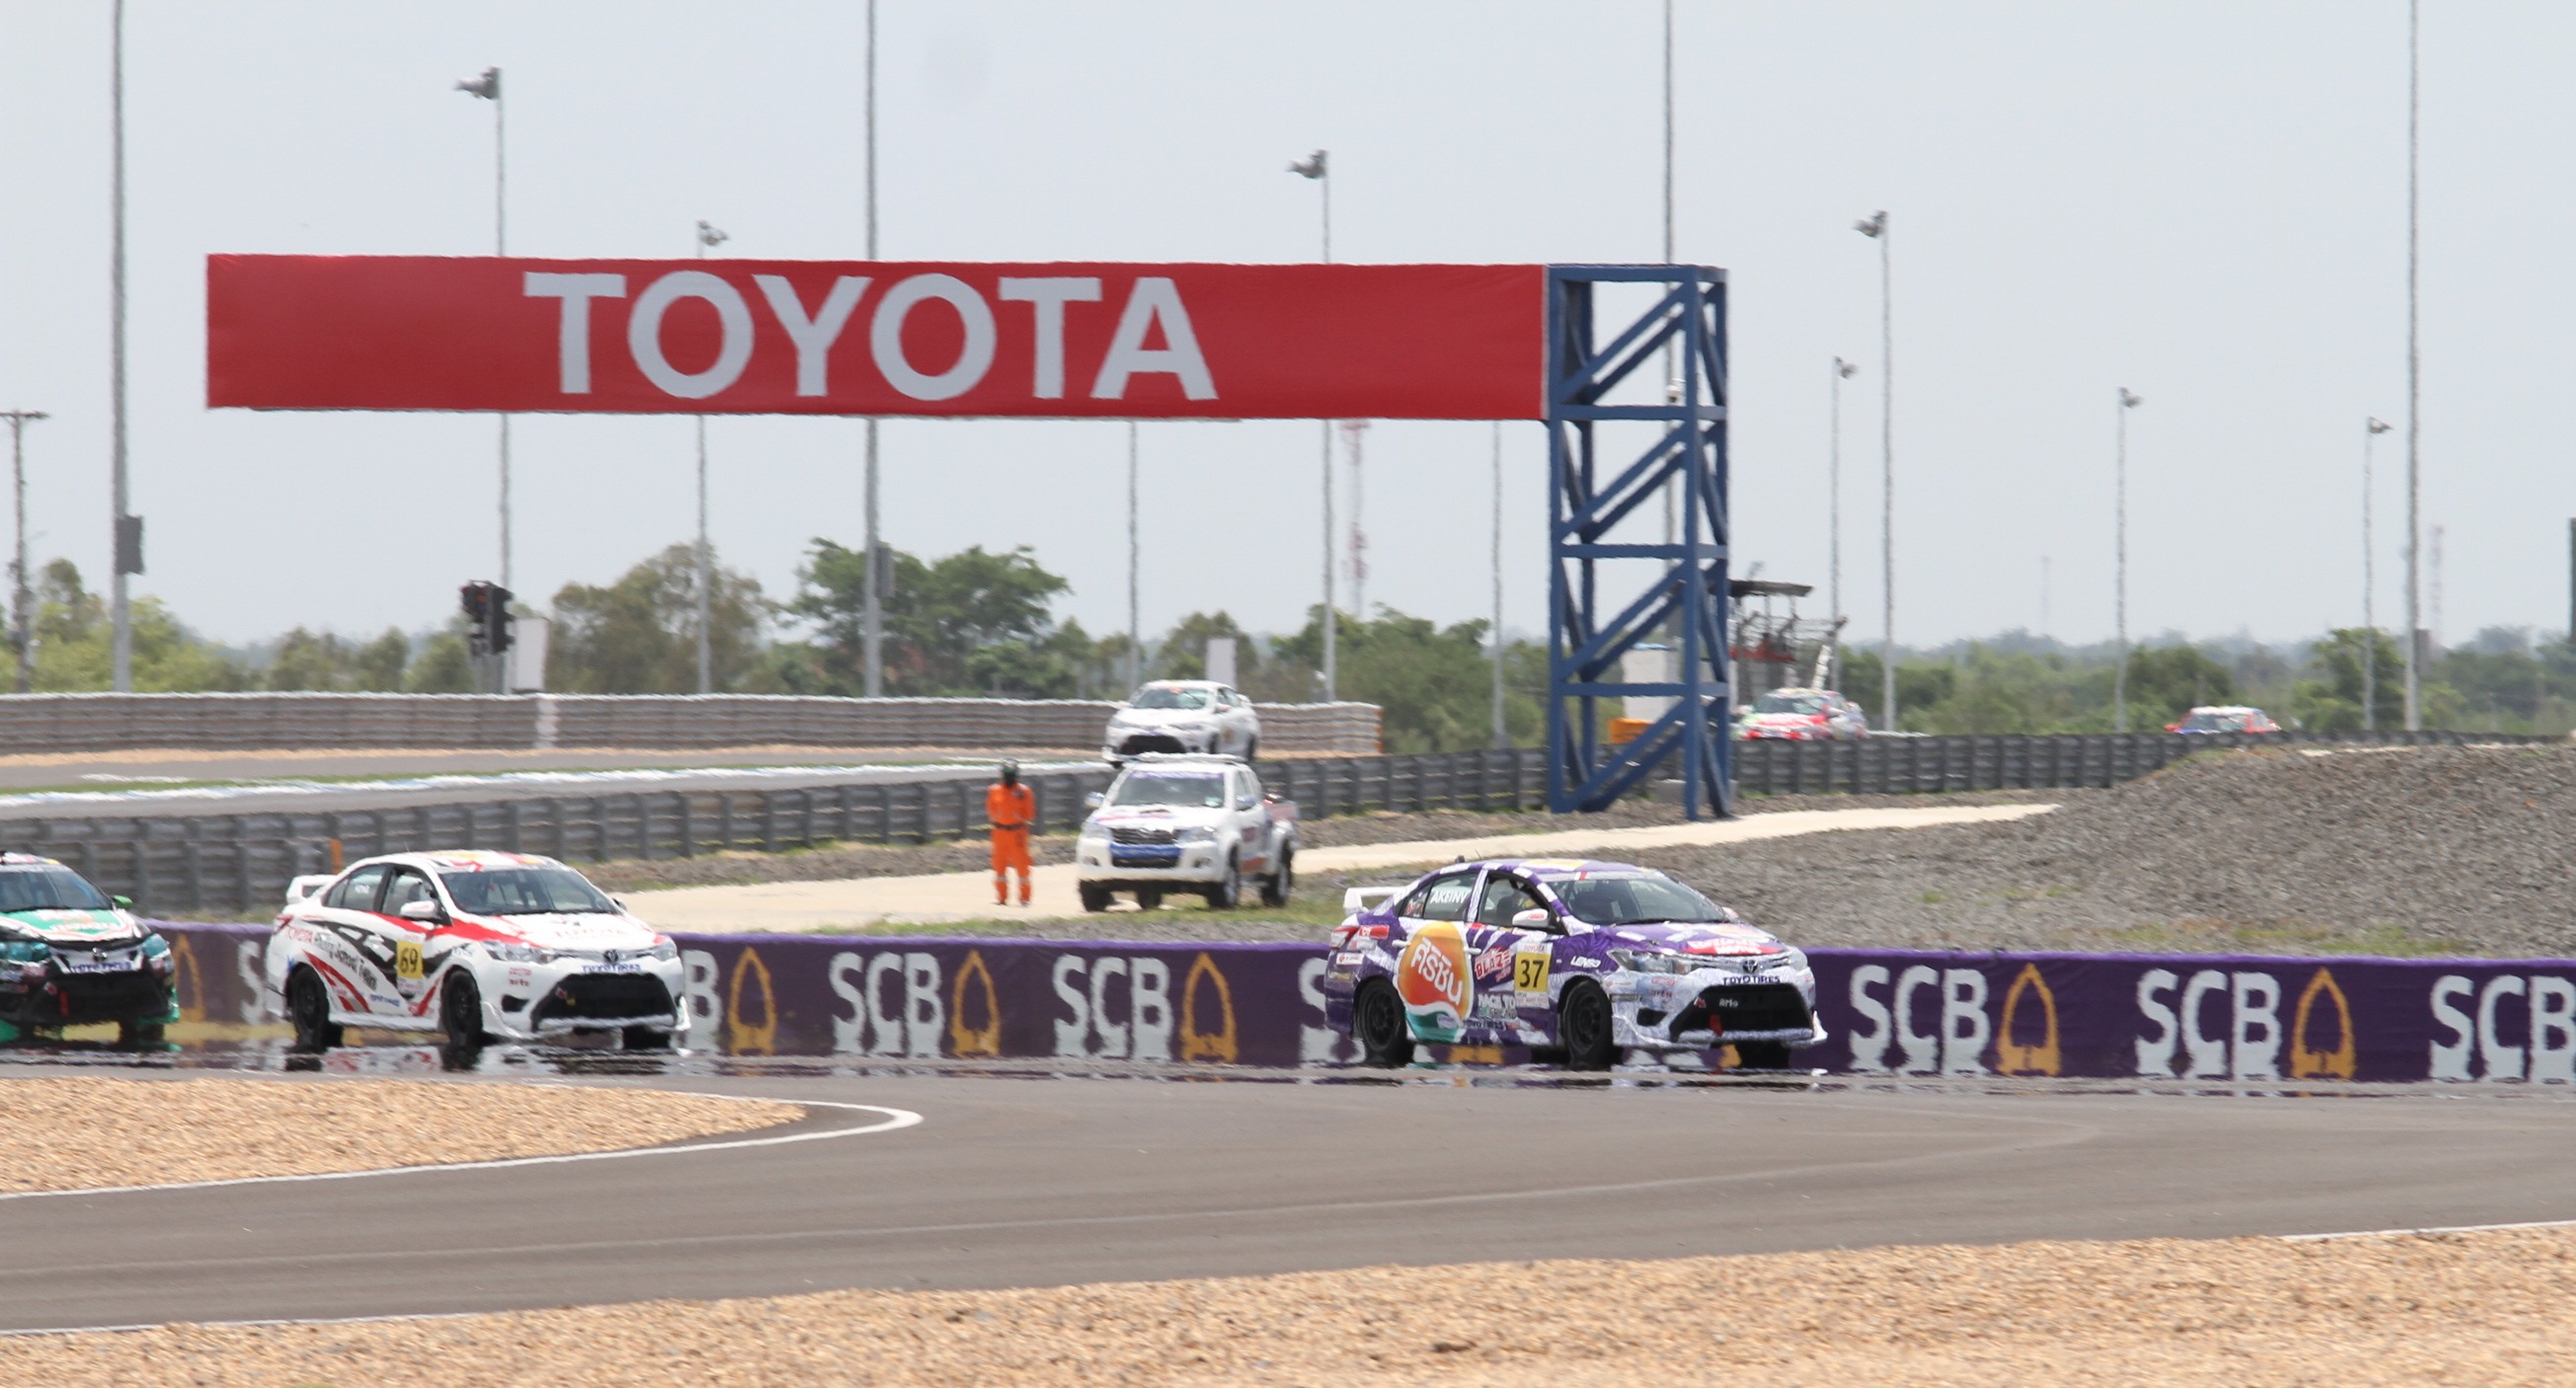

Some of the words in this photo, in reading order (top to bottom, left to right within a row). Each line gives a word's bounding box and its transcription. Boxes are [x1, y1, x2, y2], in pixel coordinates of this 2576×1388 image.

[523, 270, 1219, 401] TOYOTA
[399, 947, 418, 974] 69
[829, 952, 945, 1055] SCB
[1052, 954, 1174, 1058] SCB
[1519, 959, 1545, 988] 37
[1570, 955, 1601, 968] LENSO
[1722, 975, 1751, 985] TOYO
[1752, 974, 1780, 984] TIRES
[1850, 964, 1990, 1076] SCB
[2136, 968, 2282, 1078] SCB
[2429, 974, 2576, 1081] SCB
